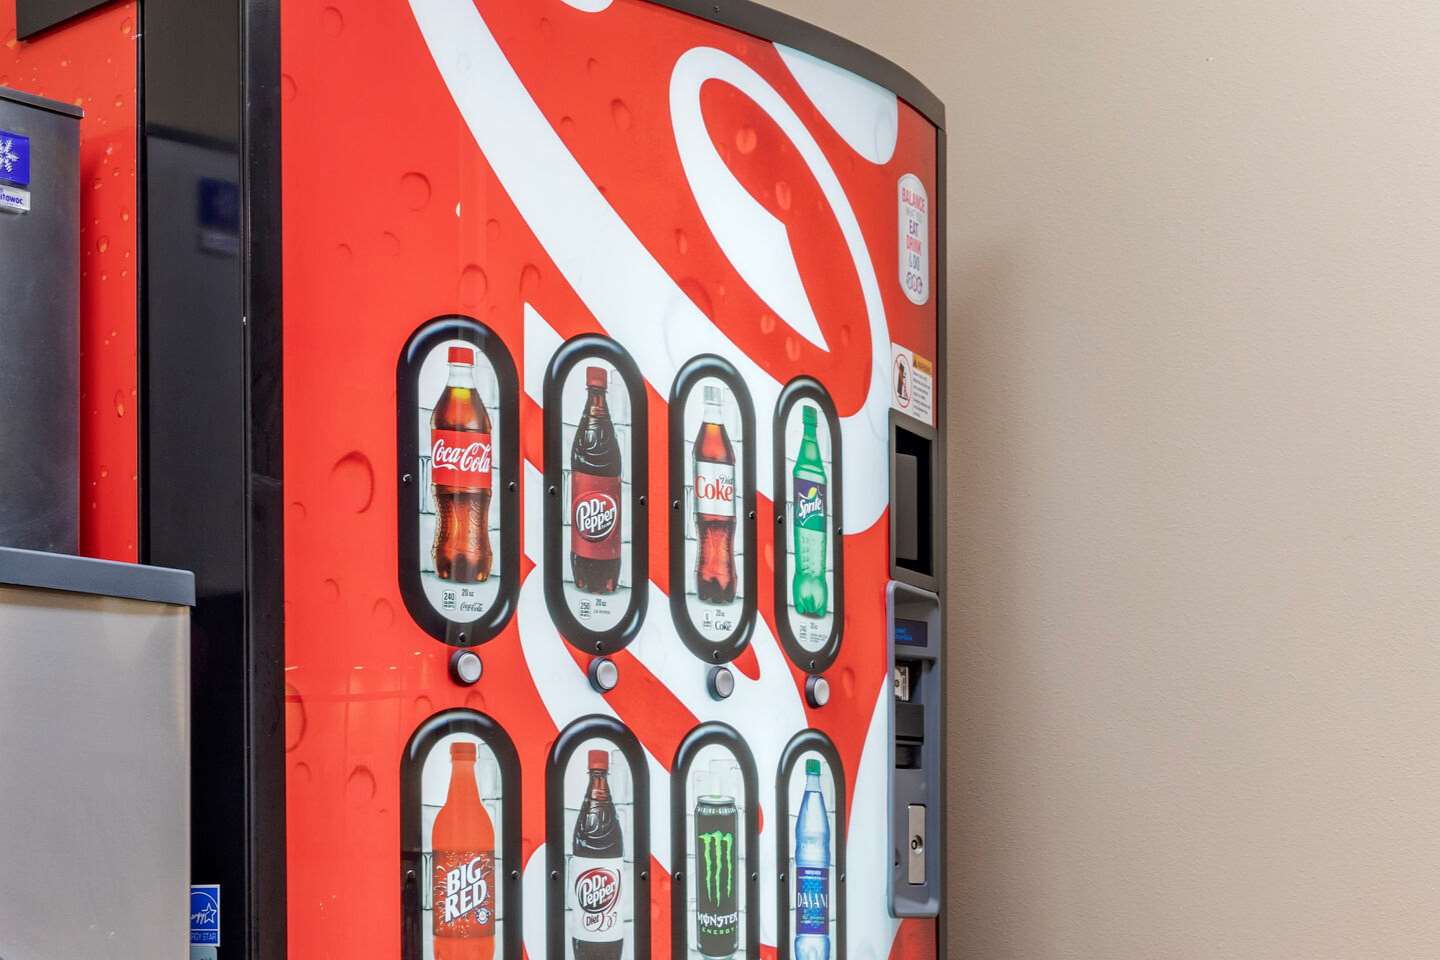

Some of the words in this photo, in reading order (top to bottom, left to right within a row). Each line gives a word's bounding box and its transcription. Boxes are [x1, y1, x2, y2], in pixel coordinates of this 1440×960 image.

[909, 220, 919, 237] EAT
[432, 439, 491, 473] Coca-Cola
[695, 475, 733, 502] Coke
[577, 501, 616, 533] Pepper
[590, 498, 606, 516] Dr
[799, 498, 822, 519] Sprite
[447, 856, 481, 896] BIG
[592, 875, 608, 891] Dr
[445, 879, 488, 922] RED
[581, 878, 616, 908] Pepper
[586, 914, 599, 926] Diet
[697, 911, 738, 928] MONSTER
[702, 927, 735, 935] ENERGY
